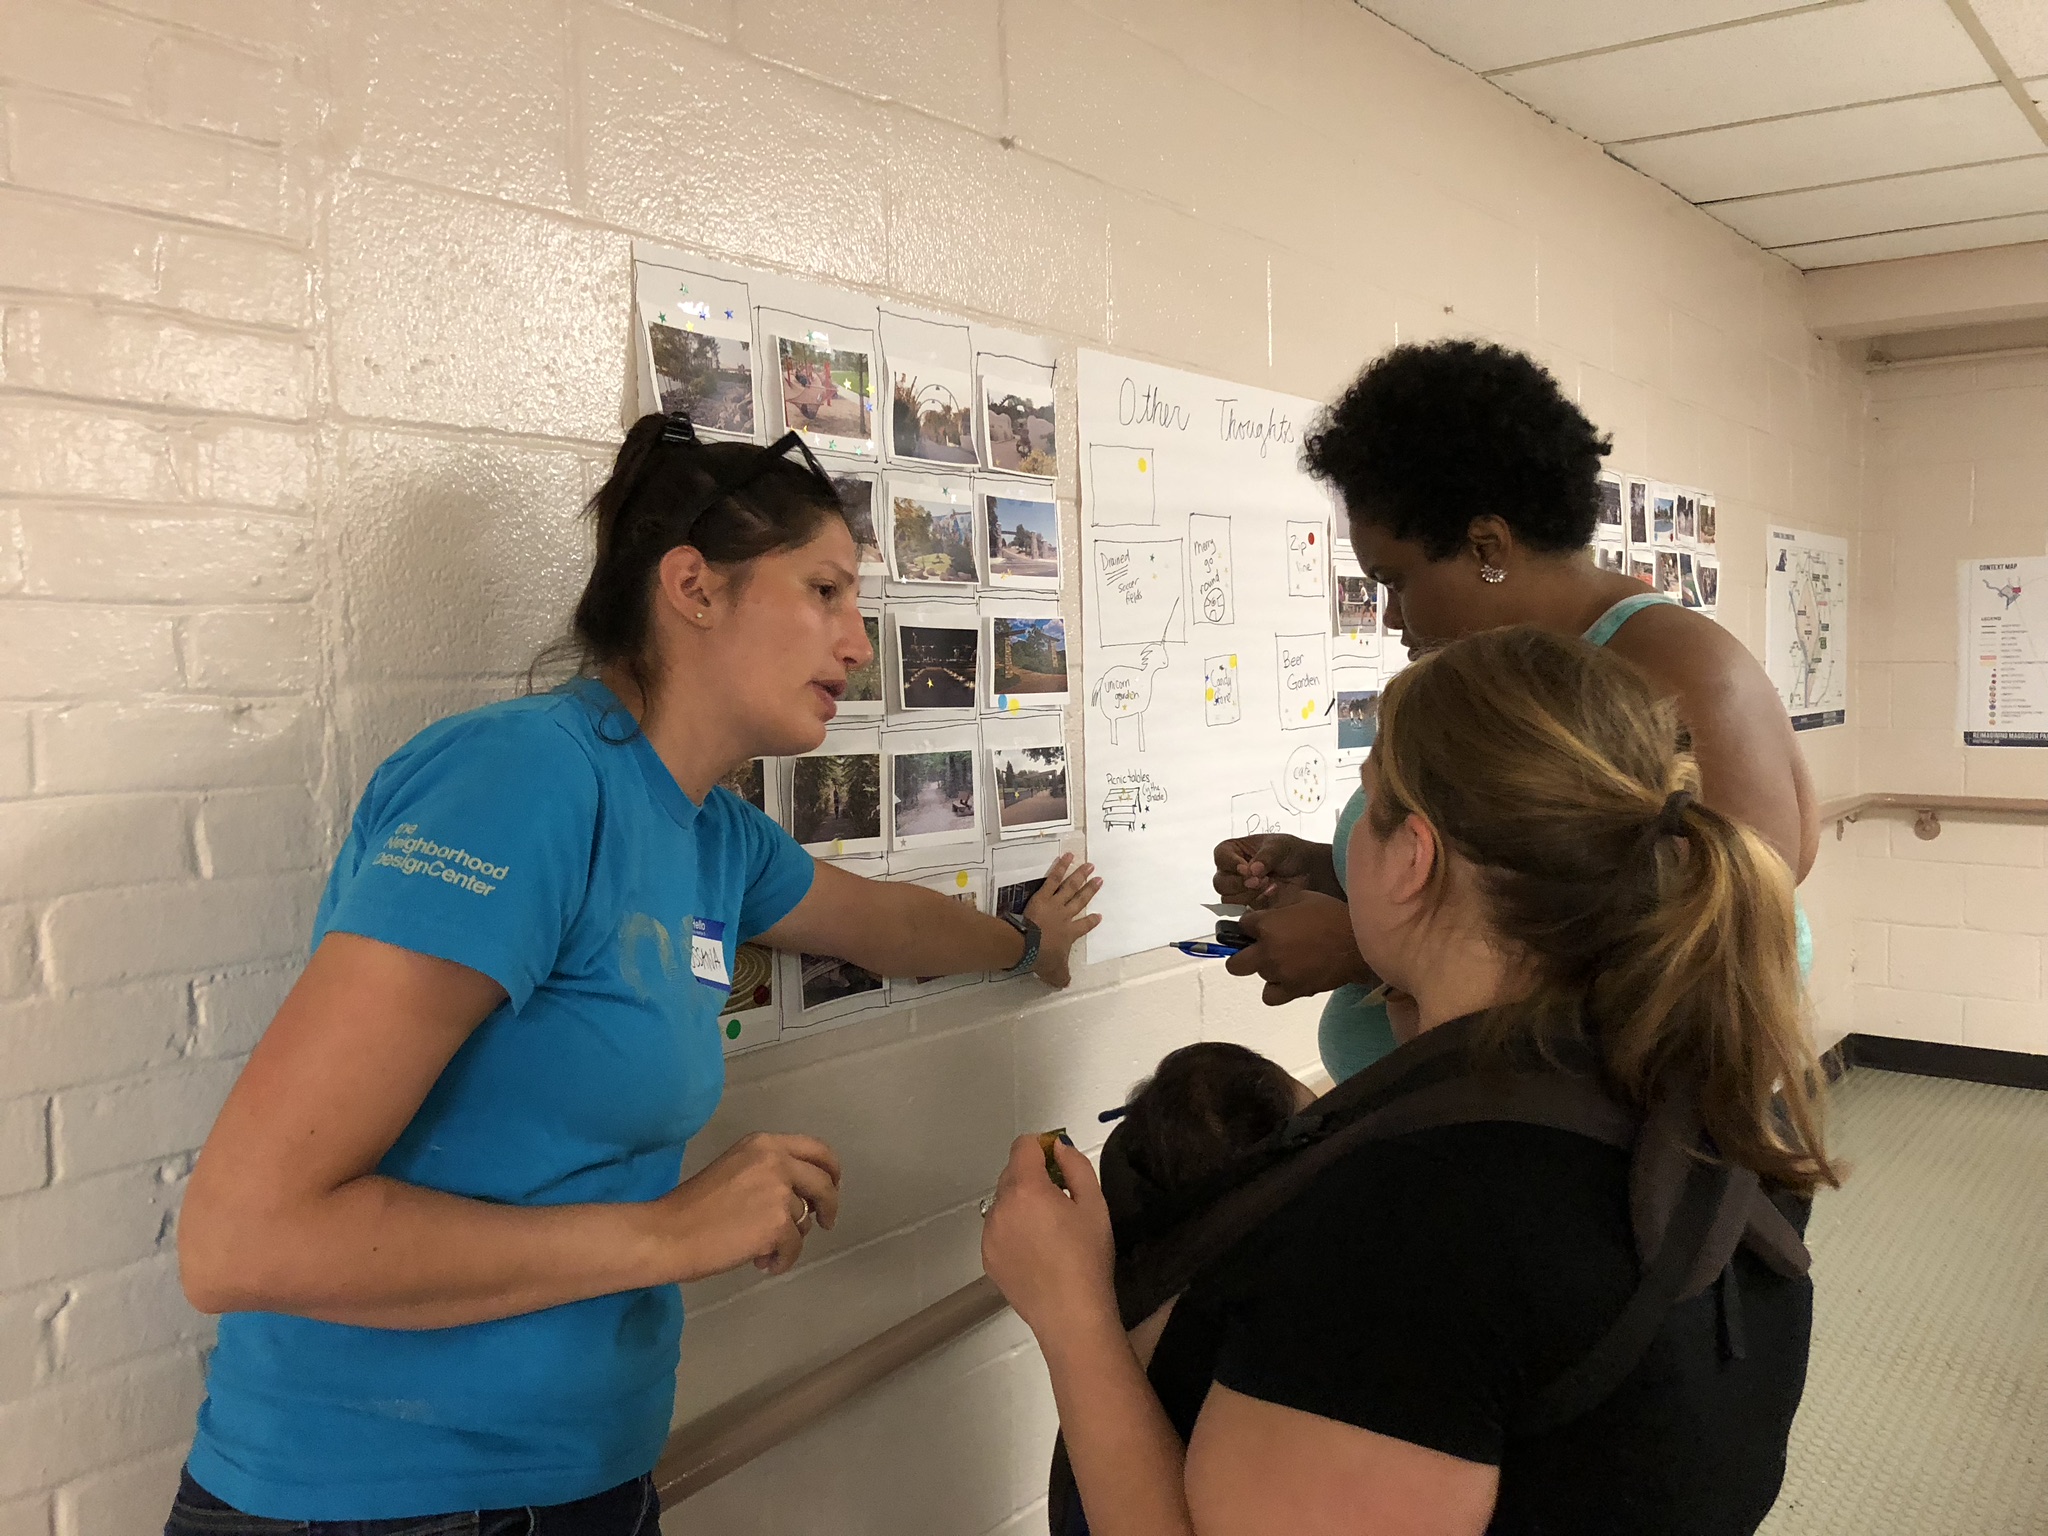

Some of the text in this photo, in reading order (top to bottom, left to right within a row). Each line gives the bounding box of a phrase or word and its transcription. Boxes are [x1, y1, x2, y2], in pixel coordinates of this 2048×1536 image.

[1119, 377, 1295, 458] Other Thoughts
[1290, 534, 1307, 556] Zip
[1100, 549, 1131, 571] Drained
[1203, 557, 1214, 574] go
[1200, 568, 1220, 595] round
[1282, 650, 1305, 669] Beer
[1287, 672, 1321, 691] Garden
[383, 835, 510, 881] Neighborhood
